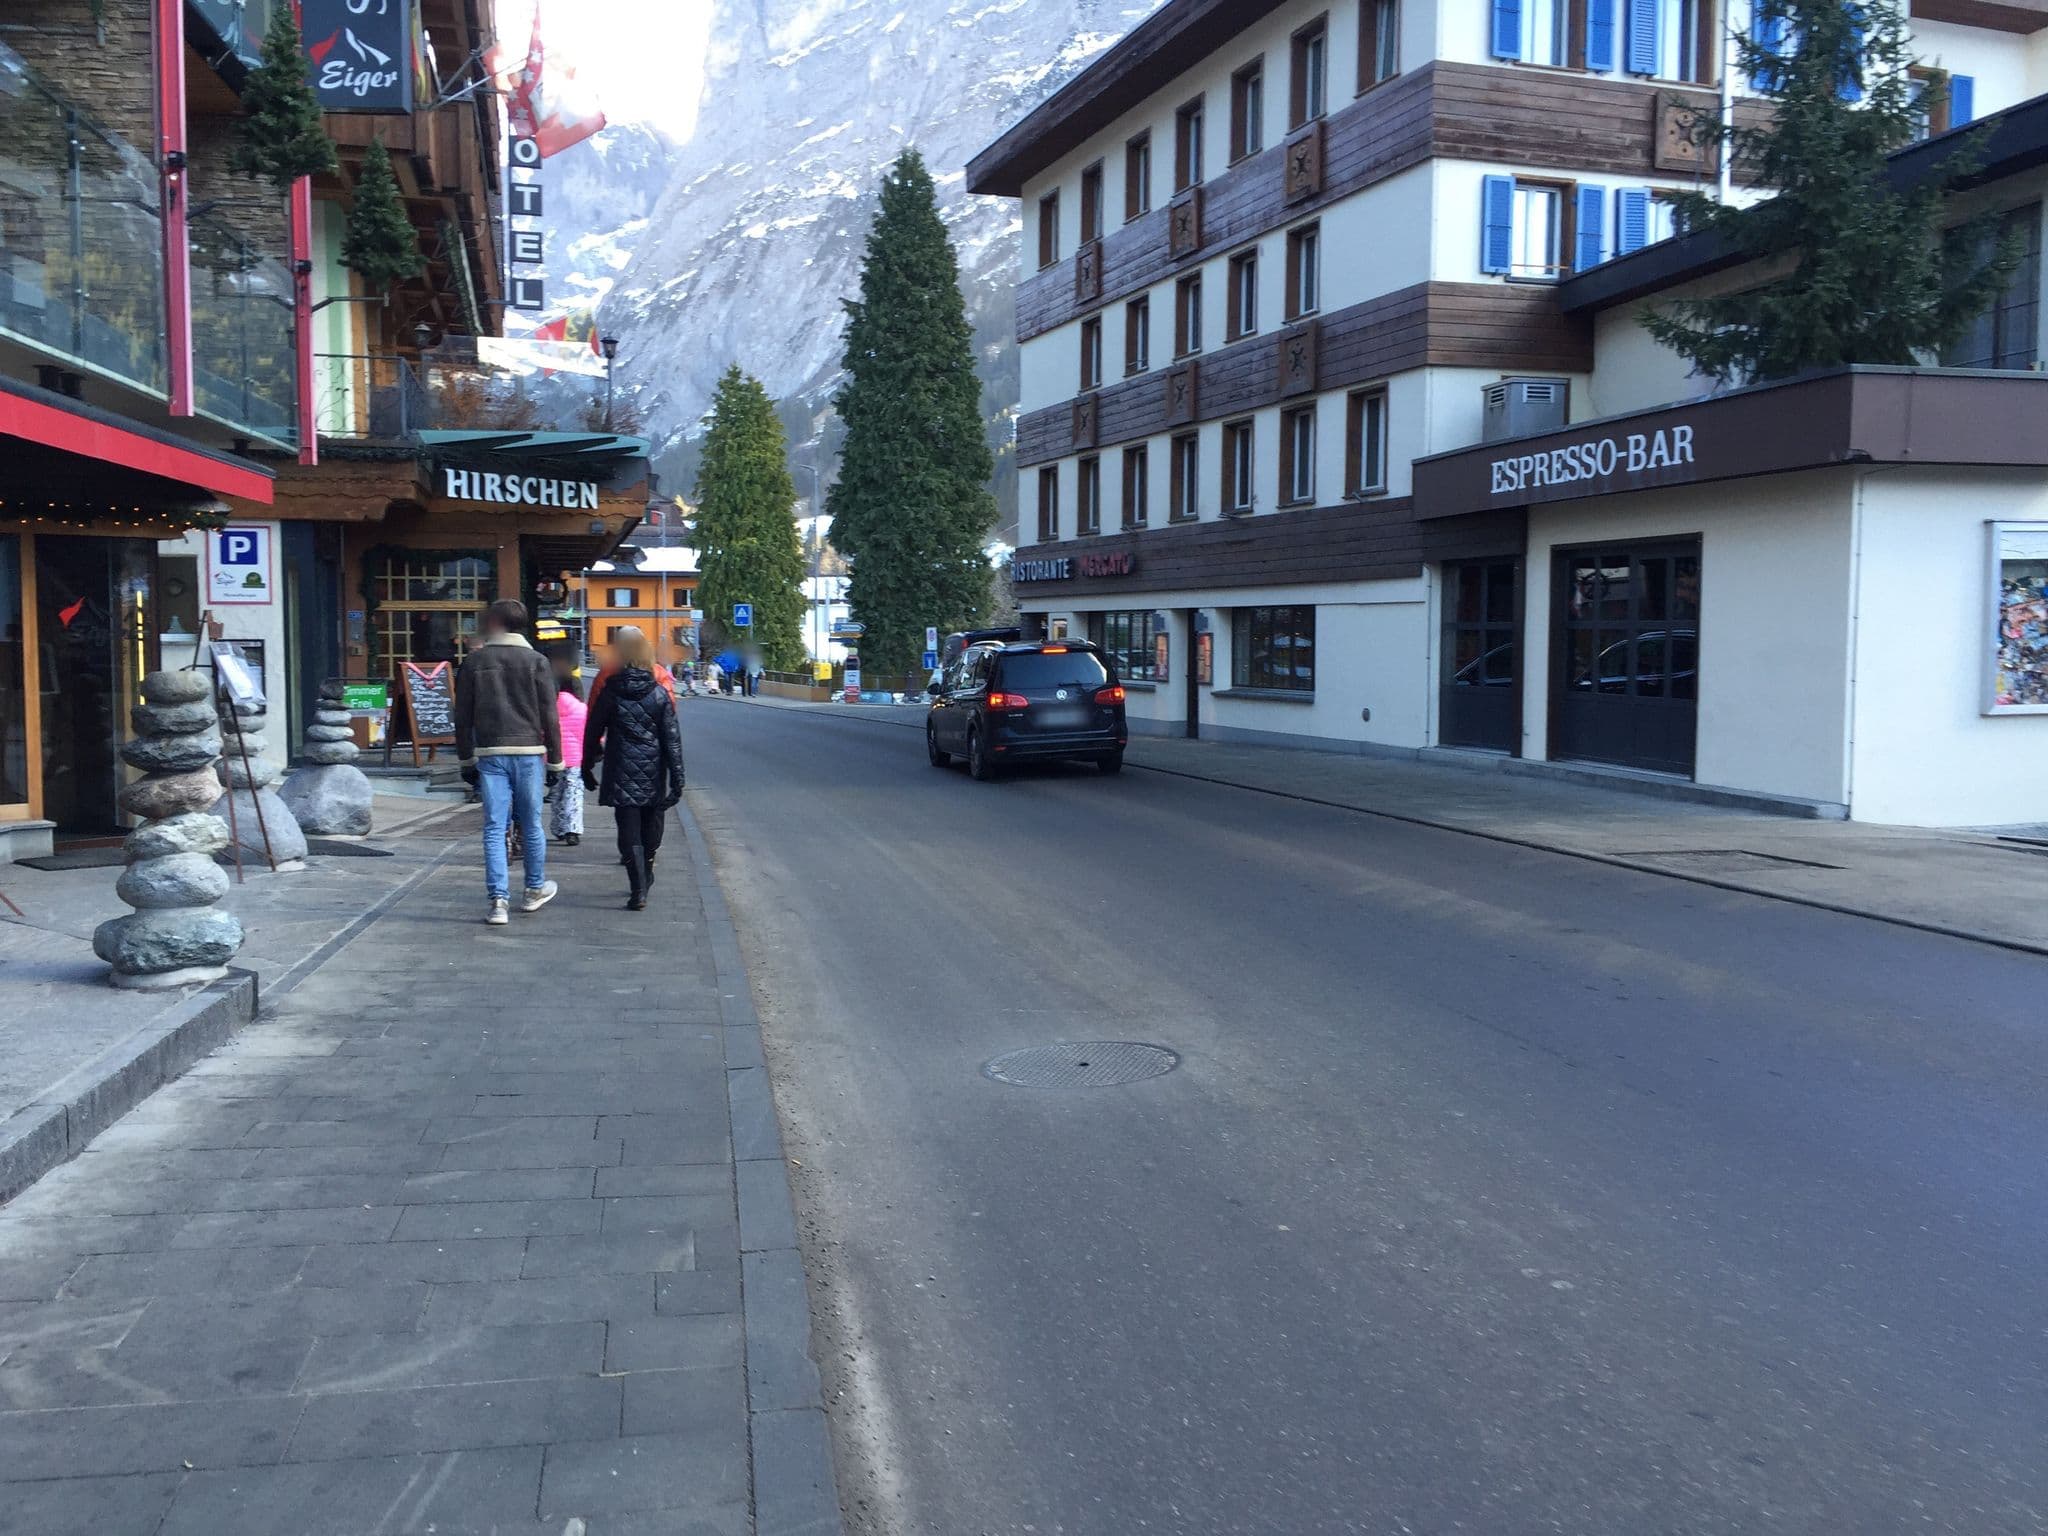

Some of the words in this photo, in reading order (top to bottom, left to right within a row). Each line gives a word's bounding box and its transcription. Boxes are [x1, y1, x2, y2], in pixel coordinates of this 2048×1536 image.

[319, 60, 398, 97] Eiger
[513, 138, 541, 307] OTEL
[1490, 425, 1695, 494] ESPRESSO-BAR
[445, 468, 599, 510] HIRSCHEN
[228, 536, 252, 562] P
[350, 699, 373, 709] Frei
